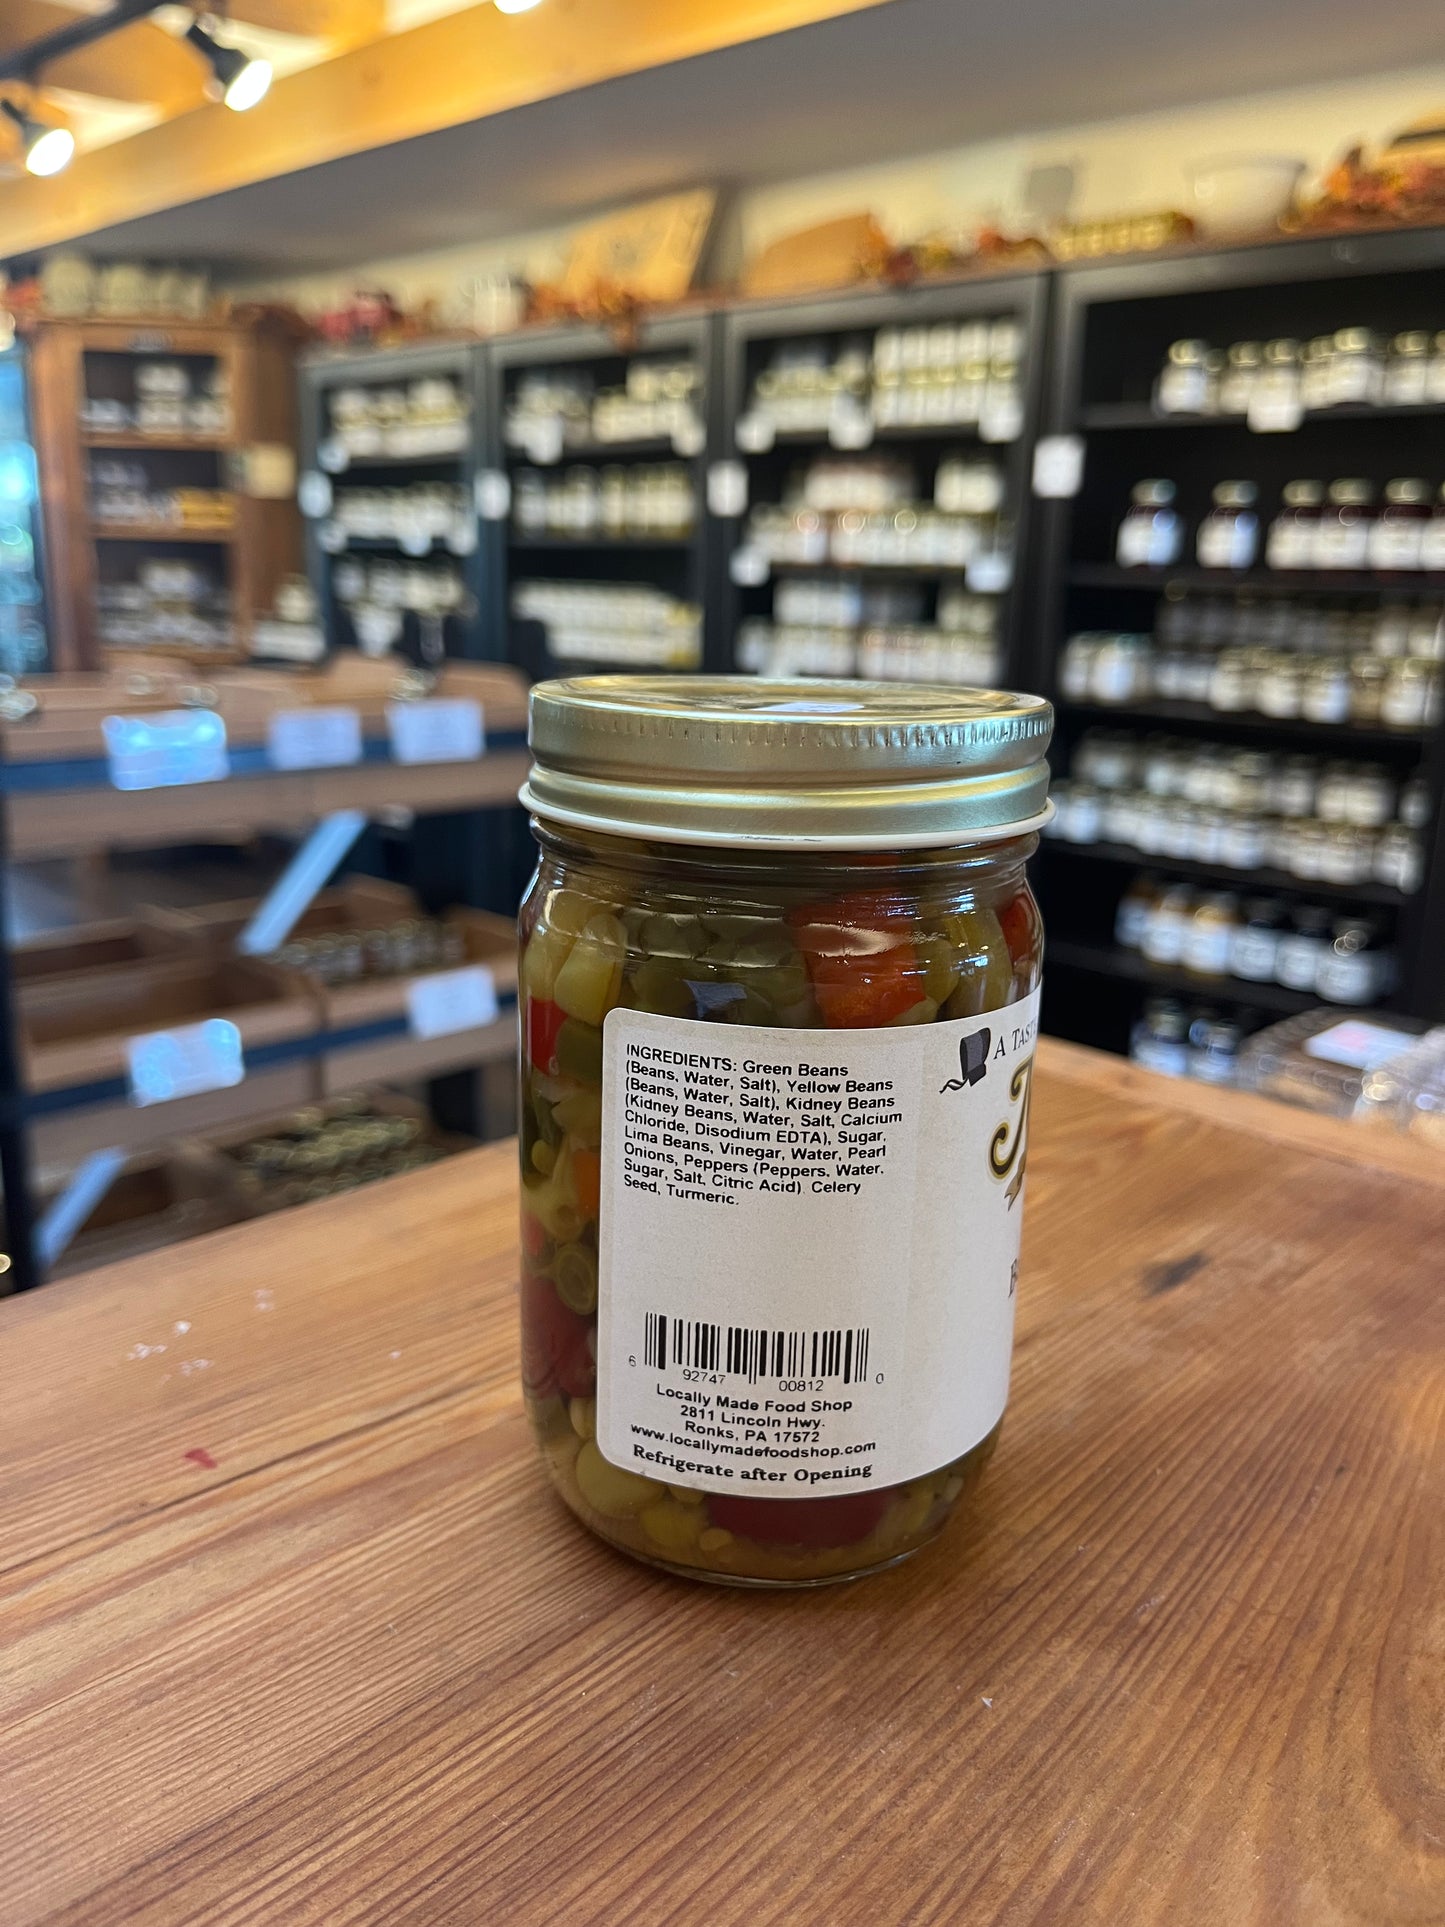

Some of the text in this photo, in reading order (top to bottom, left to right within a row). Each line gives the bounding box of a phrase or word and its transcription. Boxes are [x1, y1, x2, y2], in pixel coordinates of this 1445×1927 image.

[627, 1044, 849, 1077] INGREDIENTS: Green Beans
[993, 1035, 1006, 1060] A
[626, 1060, 894, 1094] (Beans, Water, Salt), Yellow Beans
[625, 1093, 903, 1129] (Kidney Beans, Water, Salt, Calcium
[626, 1077, 895, 1113] (Beans, Water, Salt), Kidney Beans
[625, 1110, 887, 1146] Chloride, Disodium EDTA), Sugar,
[625, 1126, 886, 1161] Lima Beans, Vinegar, Water, Pearl
[624, 1142, 678, 1166] Onions,
[685, 1154, 749, 1173] Peppers
[624, 1174, 739, 1206] Seed, Turmeric.
[625, 1158, 668, 1180] Sugar,
[674, 1169, 706, 1186] Salt,
[712, 1174, 754, 1190] Citric
[812, 1181, 861, 1195] Celery
[628, 1355, 884, 1392] 6 92747 00812 0
[657, 1383, 853, 1412] Locally Made Food Shop
[681, 1405, 825, 1430] 2811 Lincoln Hwy.
[685, 1421, 820, 1443] Ronks, PA 17572
[631, 1424, 876, 1458] www.locallymadefoodshop.com
[634, 1444, 873, 1484] Refrigerate after Opening
